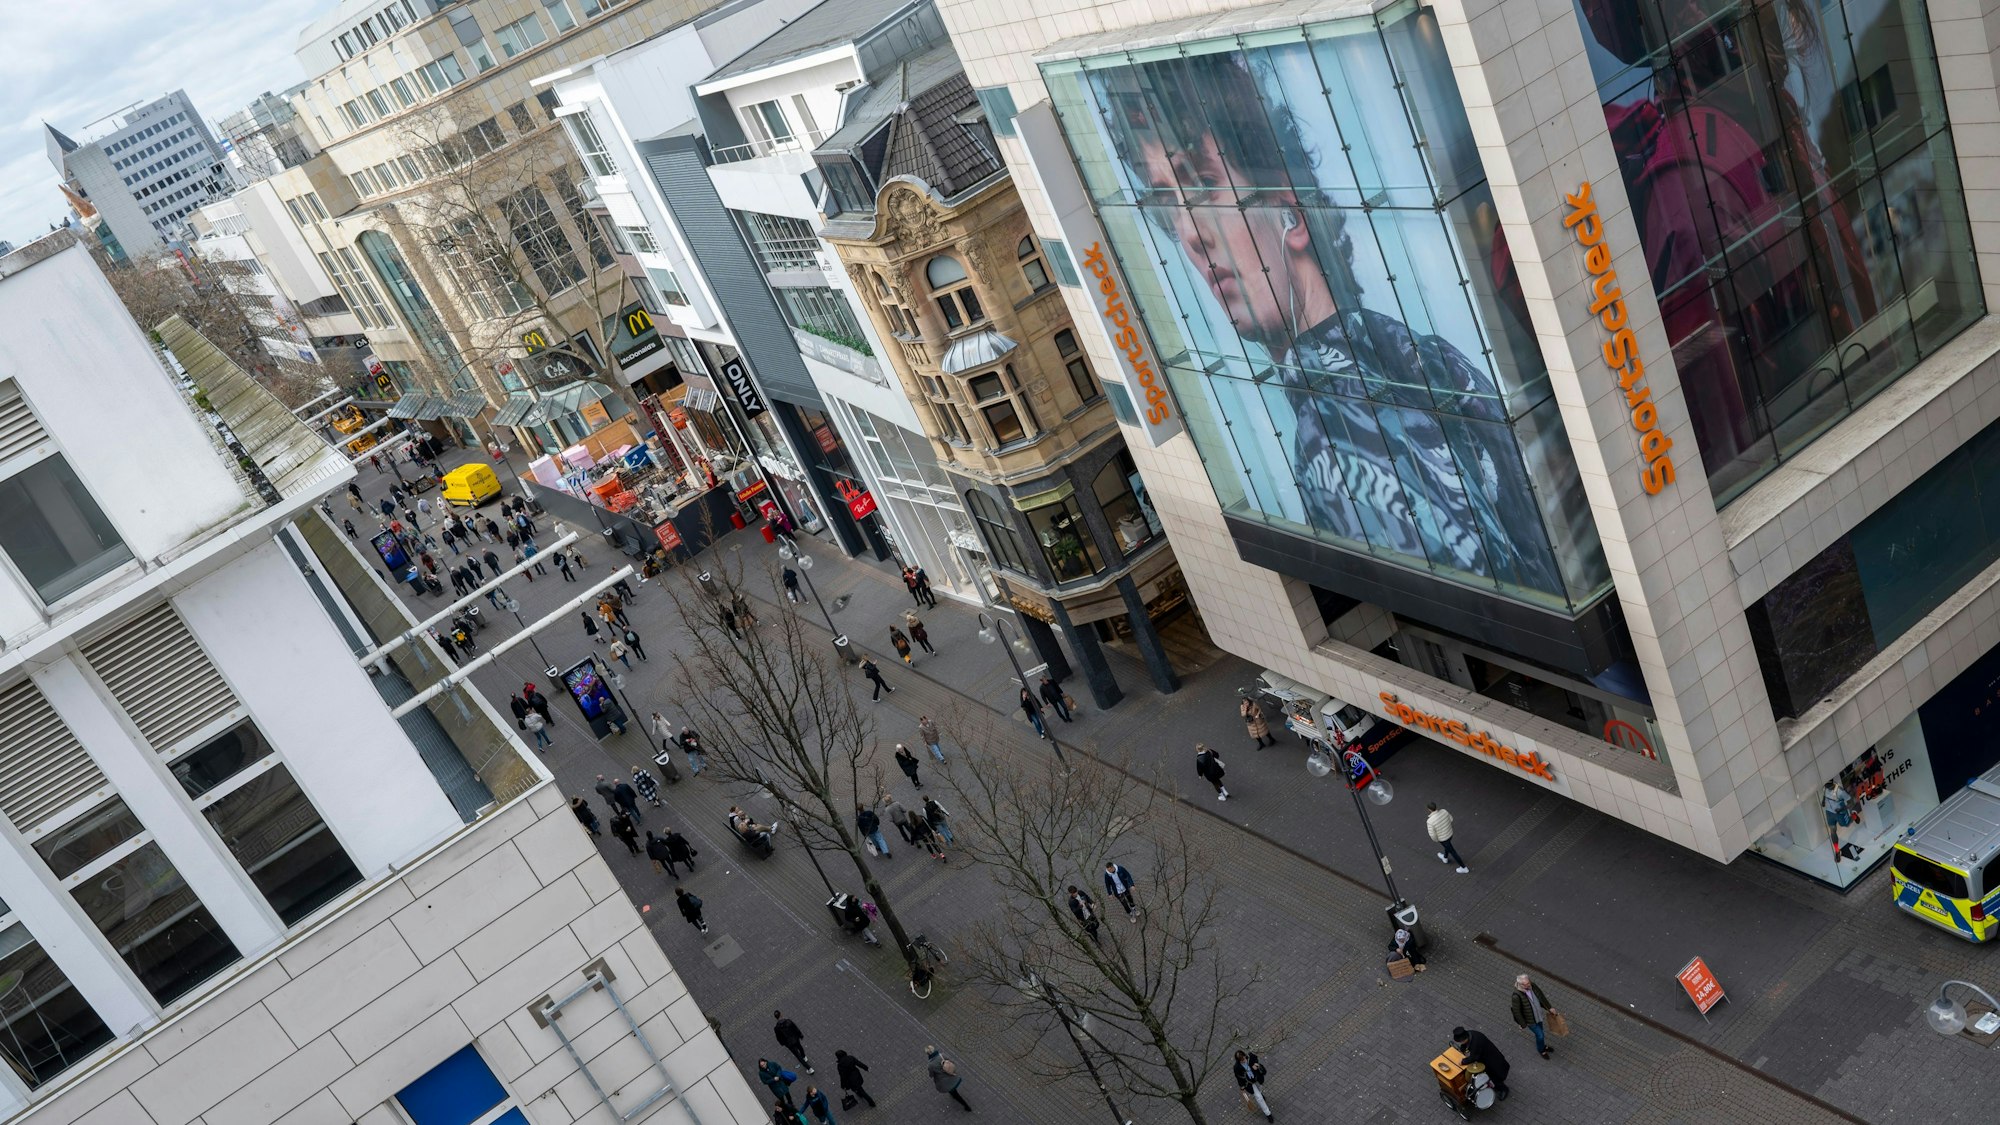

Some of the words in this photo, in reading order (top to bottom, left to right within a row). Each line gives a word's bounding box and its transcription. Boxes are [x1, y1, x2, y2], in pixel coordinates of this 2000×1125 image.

[620, 342, 656, 365] McDonald's
[1083, 241, 1170, 425] SportScheck
[1563, 181, 1675, 495] SportScheck
[544, 361, 570, 378] C&A
[727, 364, 760, 410] ONLY
[1379, 691, 1555, 782] SportScheck
